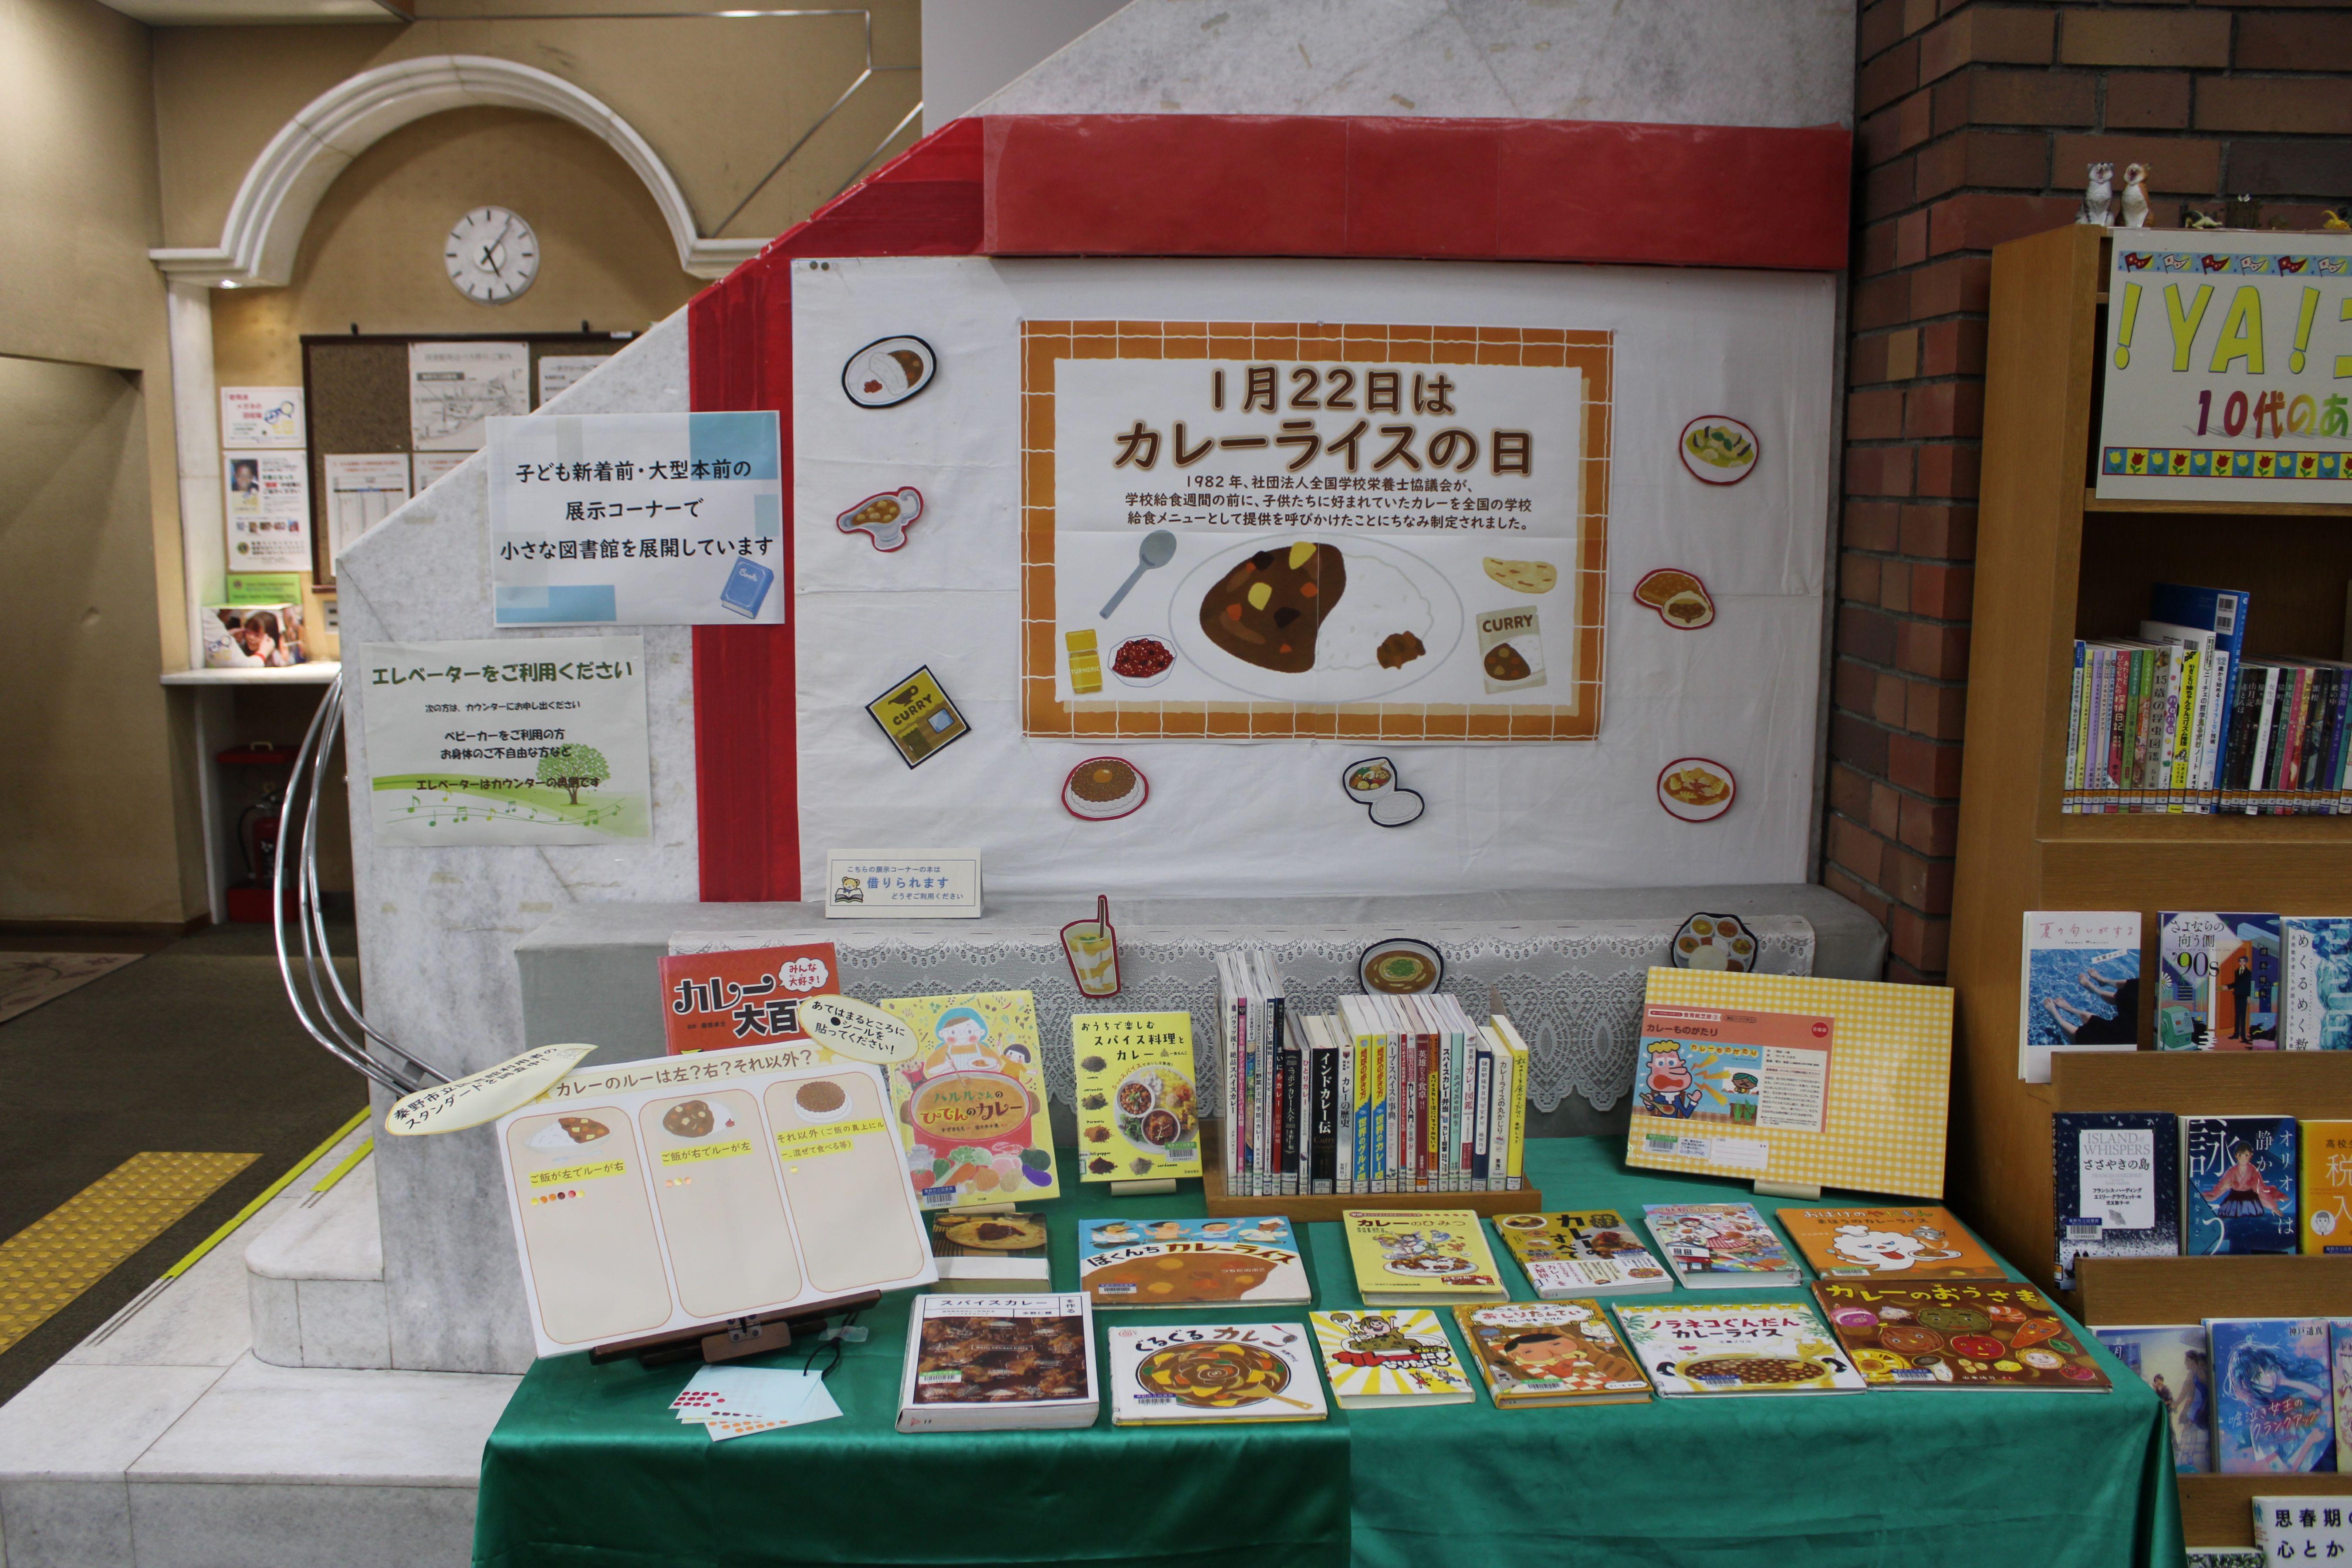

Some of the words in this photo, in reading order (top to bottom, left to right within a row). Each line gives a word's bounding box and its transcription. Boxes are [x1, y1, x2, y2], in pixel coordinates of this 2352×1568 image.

[1212, 366, 1455, 414] 1月22日は
[1114, 419, 1533, 475] カレーライスの日
[515, 458, 752, 483] 子ども新着前・大型本前の
[565, 498, 704, 521] 展示コーナーで
[1125, 493, 1532, 512] 学校給食週間の前に、子供たちに好まれていたカレーを全国の学校
[1127, 511, 1528, 530] 給食メニューとして提供を呼びかけたことにちなみ制定されました。
[500, 537, 774, 560] 小さな図書館を展開しています
[1482, 614, 1534, 634] CURRY
[372, 662, 632, 685] エレベーターをご利用ください
[1070, 665, 1100, 676] TURMERIC
[2246, 683, 2256, 706] 山月記
[2266, 684, 2275, 705] 女生徒
[2276, 684, 2285, 701] 猫町
[2338, 684, 2348, 706] 魔術師
[425, 701, 580, 713] 次の方は、カウンターにお申し出ください
[892, 694, 933, 726] CURRY
[2113, 695, 2126, 730] 探偵日記
[2149, 676, 2167, 762] 15歳の昆虫図鑑
[445, 728, 565, 741] ベビーカーをご利用の方
[440, 747, 571, 760] お身体のご不自由な方など
[867, 877, 950, 889] 借りられます
[2040, 923, 2133, 939] 夏の匂いがする
[2171, 920, 2224, 933] さよならの
[2178, 935, 2214, 947] 向う側
[789, 963, 817, 973] みんな
[789, 976, 820, 987] 大好き!
[673, 973, 776, 1014] カレー
[733, 996, 813, 1038] 大百
[812, 1001, 905, 1037] あてはまるところに
[1081, 1021, 1155, 1031] おうちで楽しむ
[815, 1022, 895, 1054] 貼ってください!
[1095, 1033, 1185, 1046] スパイス料理と
[1646, 1024, 1718, 1037] カレーものがたり
[1117, 1051, 1154, 1061] カレー
[1691, 1044, 1758, 1057] カレーものがたり
[557, 1049, 812, 1098] カレーのルーは左?右?それ以外?
[1275, 1046, 1284, 1107] まいにちカレー
[1388, 1041, 1397, 1120] ハーブ・スパイスの事典
[1418, 1050, 1427, 1099] 英雄たちの食卓
[1442, 1048, 1450, 1113] スパイスカレー弁当
[1464, 1048, 1475, 1110] 世界のカレー図鑑
[934, 1091, 1003, 1103] ハルルさんの
[1286, 1067, 1295, 1122] ニッポンカレー大全
[1319, 1052, 1332, 1134] インドカレー伝
[1340, 1077, 1350, 1128] カレーの歴史
[1497, 1061, 1507, 1135] カレーライスの丸かじり
[920, 1102, 1022, 1124] ひでんのカレー
[2084, 1144, 2150, 1155] WHISPERS
[2088, 1133, 2138, 1144] ISLAND
[661, 1142, 750, 1162] ご飯が右でルーが左
[2255, 1130, 2274, 1194] 静かに
[530, 1161, 625, 1184] ご飯が左でルーが右
[2083, 1158, 2149, 1170] ささやきの島
[2278, 1130, 2294, 1234] オリオンは
[1549, 1233, 1580, 1259] すべて
[1556, 1214, 1601, 1257] カレーの
[1087, 1245, 1160, 1267] ぼくんち
[1165, 1243, 1297, 1264] カレーライス
[1826, 1284, 2040, 1302] カレーのおうさま
[1066, 1299, 1076, 1314] を作る
[1482, 1310, 1581, 1319] おしりたんてい
[1650, 1318, 1801, 1329] ノラネコぐんだん
[1672, 1329, 1784, 1338] カレーライス
[1135, 1328, 1204, 1352] ぐるぐる
[2228, 1399, 2302, 1428] 嘘泣き女王の
[2253, 1409, 2320, 1440] クランクアップ
[2275, 1509, 2352, 1527] 思春期
[2277, 1540, 2344, 1558] 心とか
